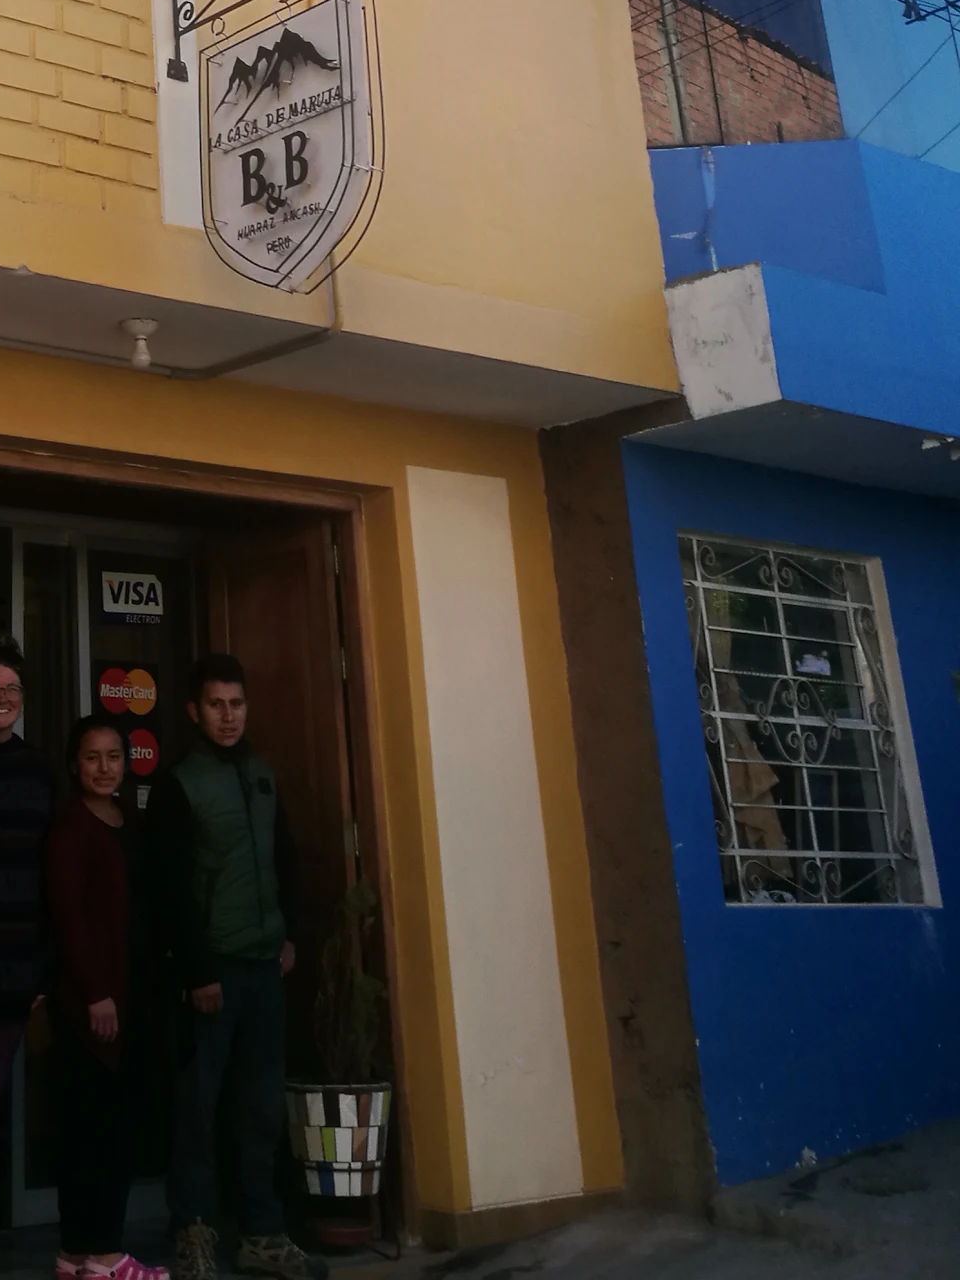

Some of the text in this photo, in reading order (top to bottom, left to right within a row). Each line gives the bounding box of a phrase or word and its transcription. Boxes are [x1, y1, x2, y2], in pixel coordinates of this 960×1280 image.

[227, 119, 259, 143] CASA
[265, 107, 286, 128] DE
[289, 85, 343, 120] MARUJA
[237, 202, 320, 240] HUARAZ ANCASH
[105, 580, 160, 606] VISA
[126, 614, 161, 624] ELECTRON
[100, 683, 156, 701] MasterCard
[130, 746, 154, 760] stro
